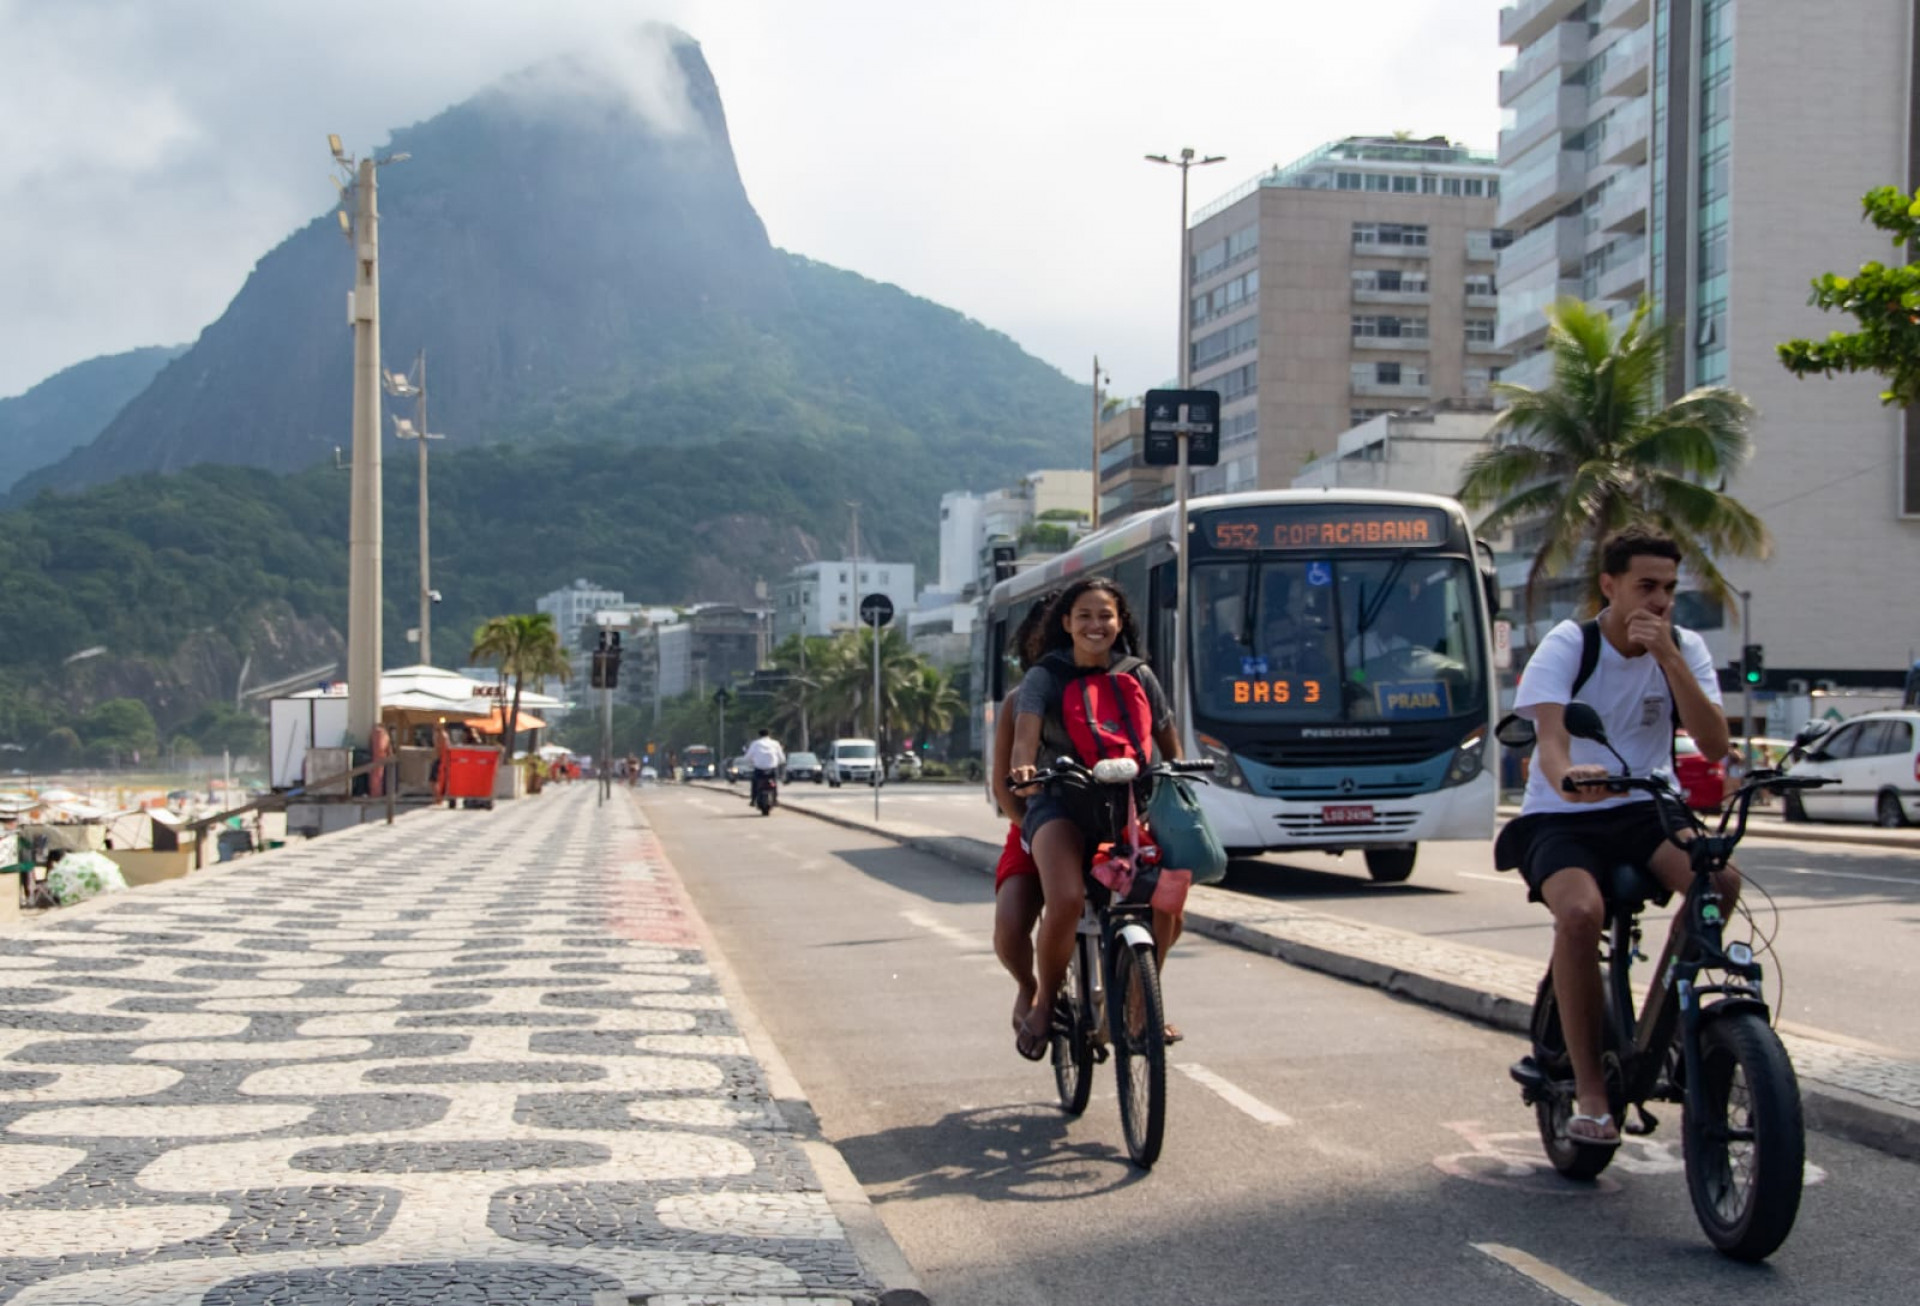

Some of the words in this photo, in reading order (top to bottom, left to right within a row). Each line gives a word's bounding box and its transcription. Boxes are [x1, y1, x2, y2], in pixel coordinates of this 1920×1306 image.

[1216, 523, 1259, 547] 552
[1274, 519, 1429, 544] COPACABANA
[1234, 681, 1290, 703] BRS
[1303, 681, 1320, 703] 3
[1387, 692, 1441, 710] PRAIA
